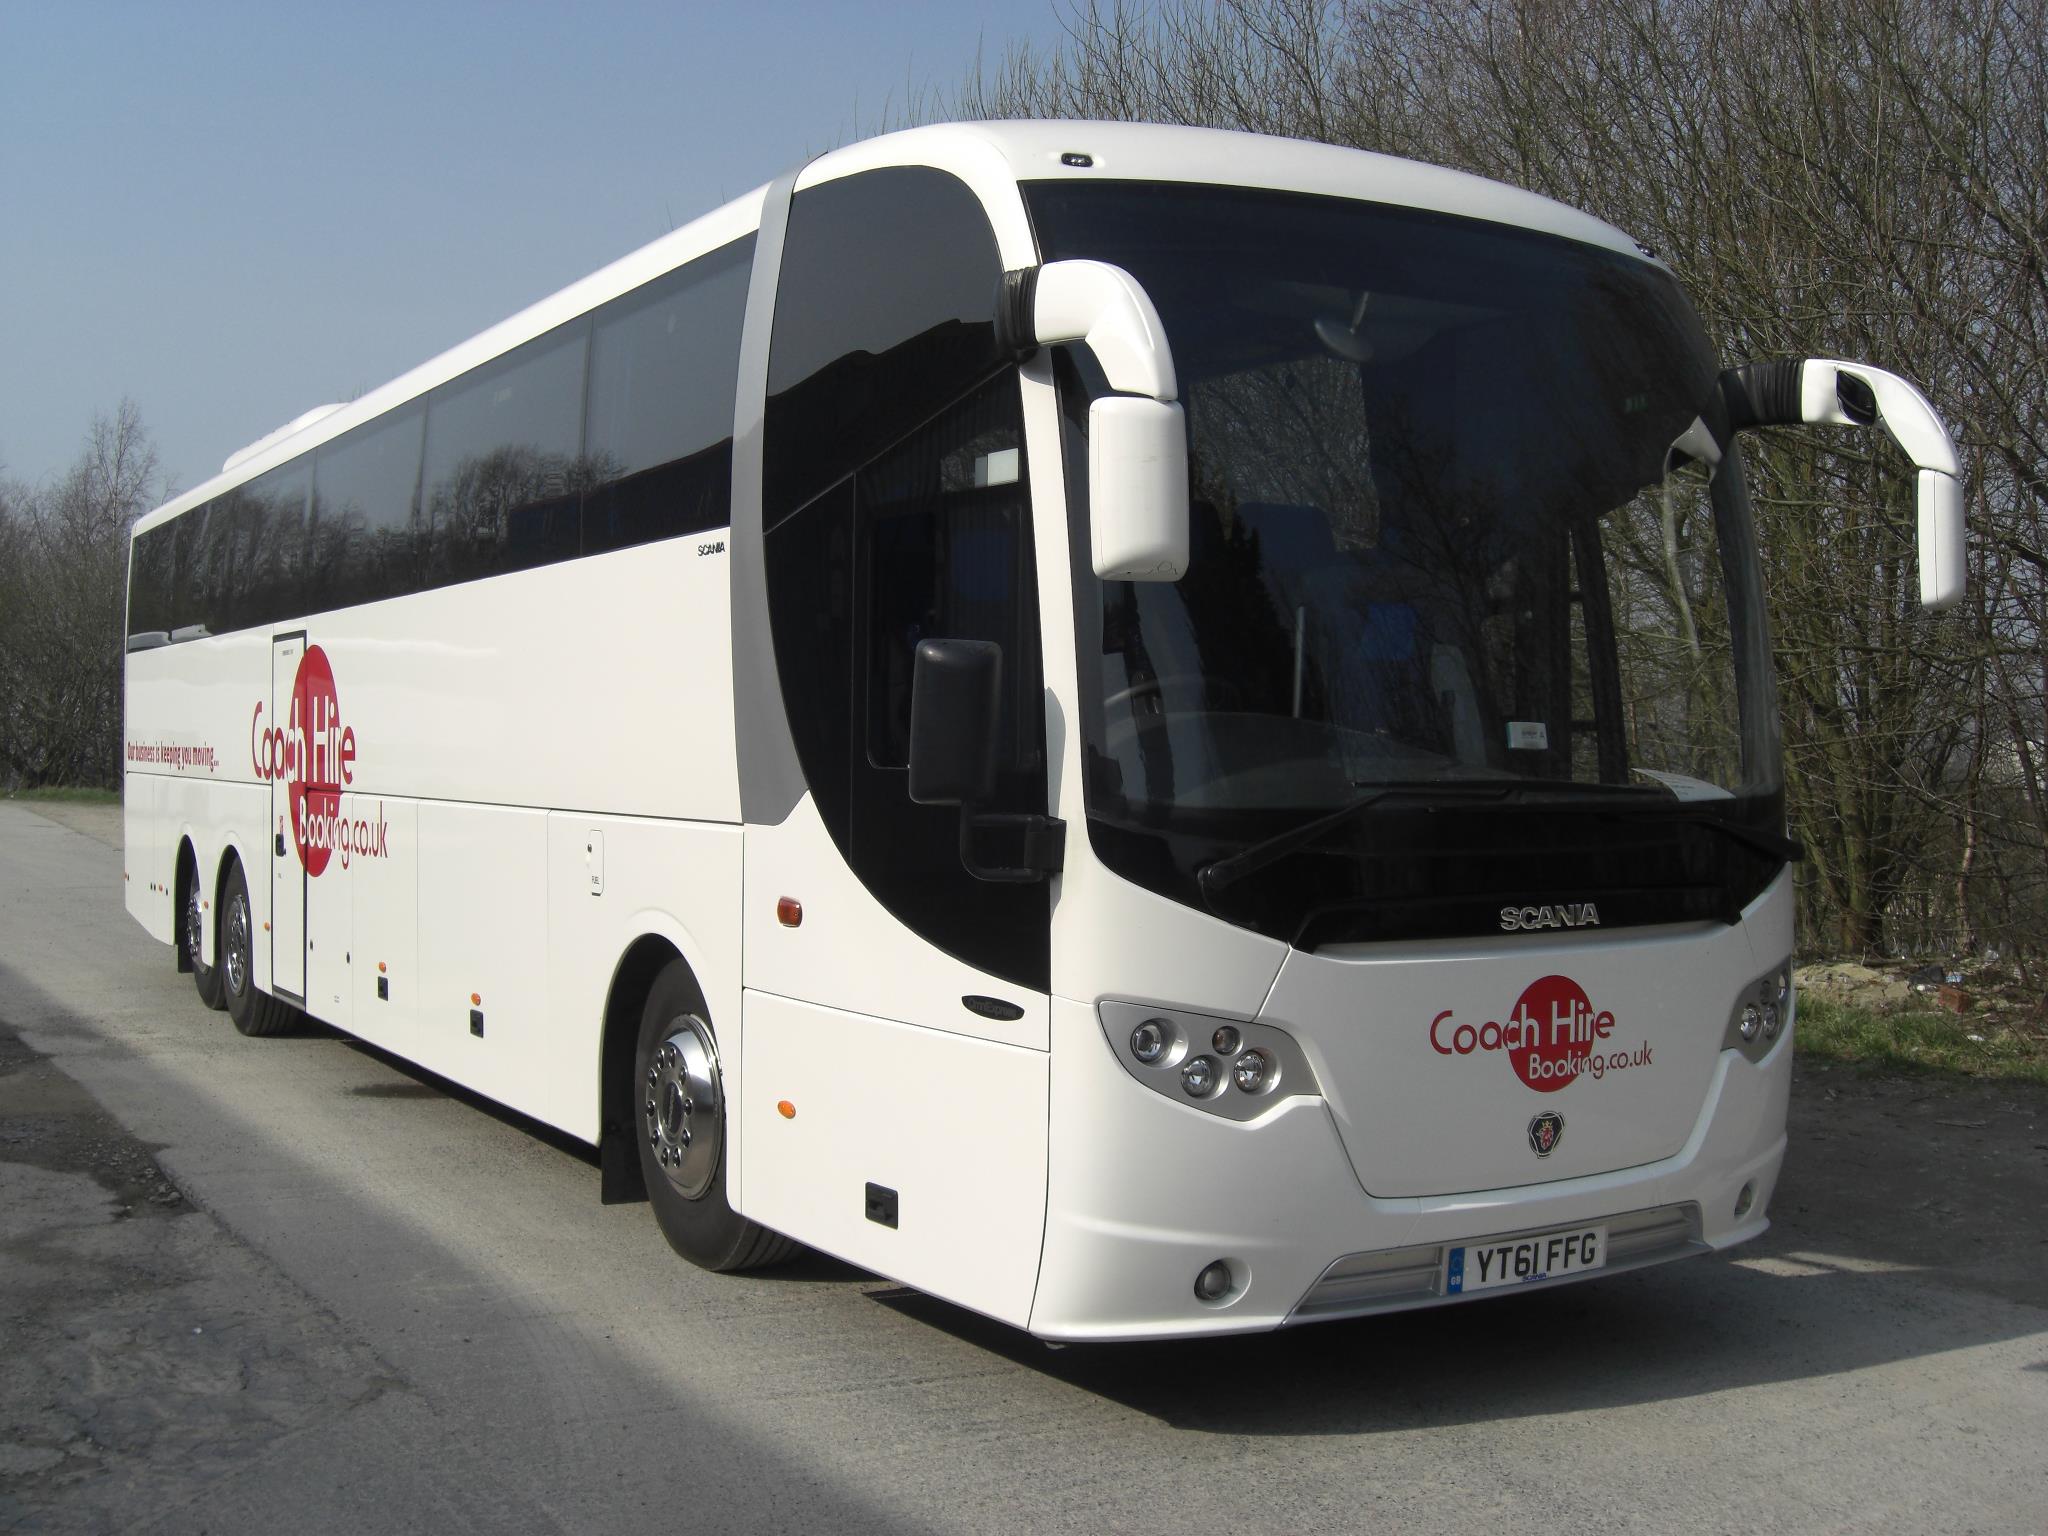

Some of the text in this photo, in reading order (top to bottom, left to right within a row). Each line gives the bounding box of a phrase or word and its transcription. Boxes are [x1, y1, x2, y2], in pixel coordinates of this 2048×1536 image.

[698, 542, 725, 556] SCANIA
[136, 741, 155, 763] business
[161, 741, 181, 770] keeping
[182, 746, 192, 770] you
[252, 696, 356, 784] Coach Hire
[300, 796, 388, 870] Booking.co.uk
[1501, 903, 1600, 930] SCANIA
[966, 998, 1018, 1018] OmExpr
[1430, 1000, 1615, 1055] Coach Hire
[1529, 1040, 1652, 1080] Booking.co.uk
[1477, 1232, 1597, 1282] YT61 FFG
[1450, 1275, 1461, 1285] GB
